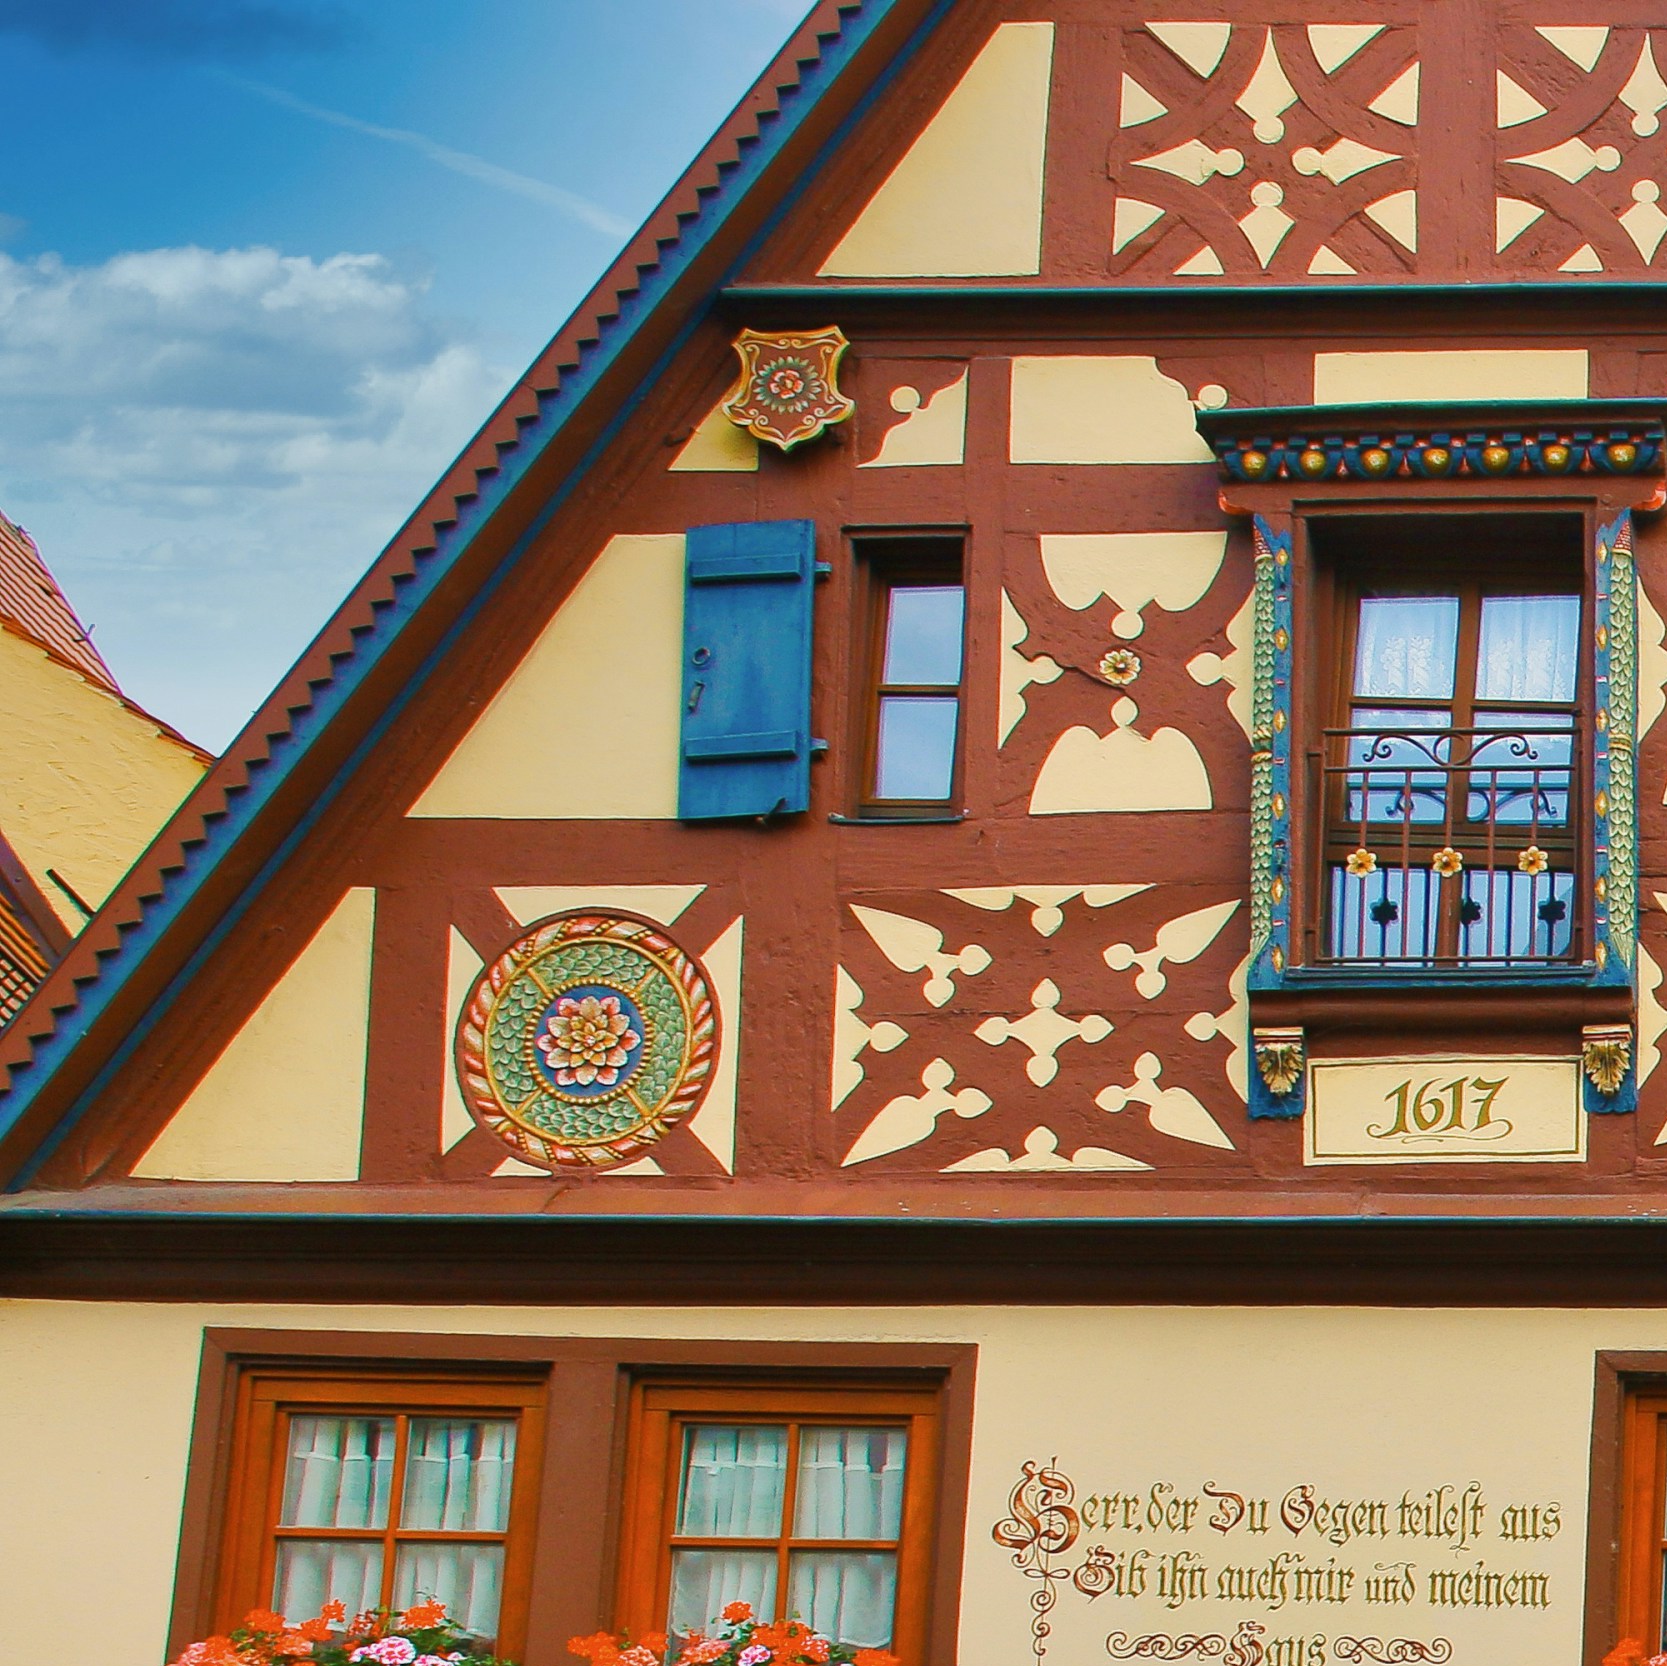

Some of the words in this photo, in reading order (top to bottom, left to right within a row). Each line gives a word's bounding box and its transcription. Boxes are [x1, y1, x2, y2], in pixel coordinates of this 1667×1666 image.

[1367, 1076, 1513, 1140] 1617
[1203, 1481, 1270, 1536] Du
[1498, 1501, 1561, 1541] aus
[1294, 1557, 1354, 1604] mir
[1364, 1561, 1417, 1604] und
[1428, 1560, 1551, 1610] meinem
